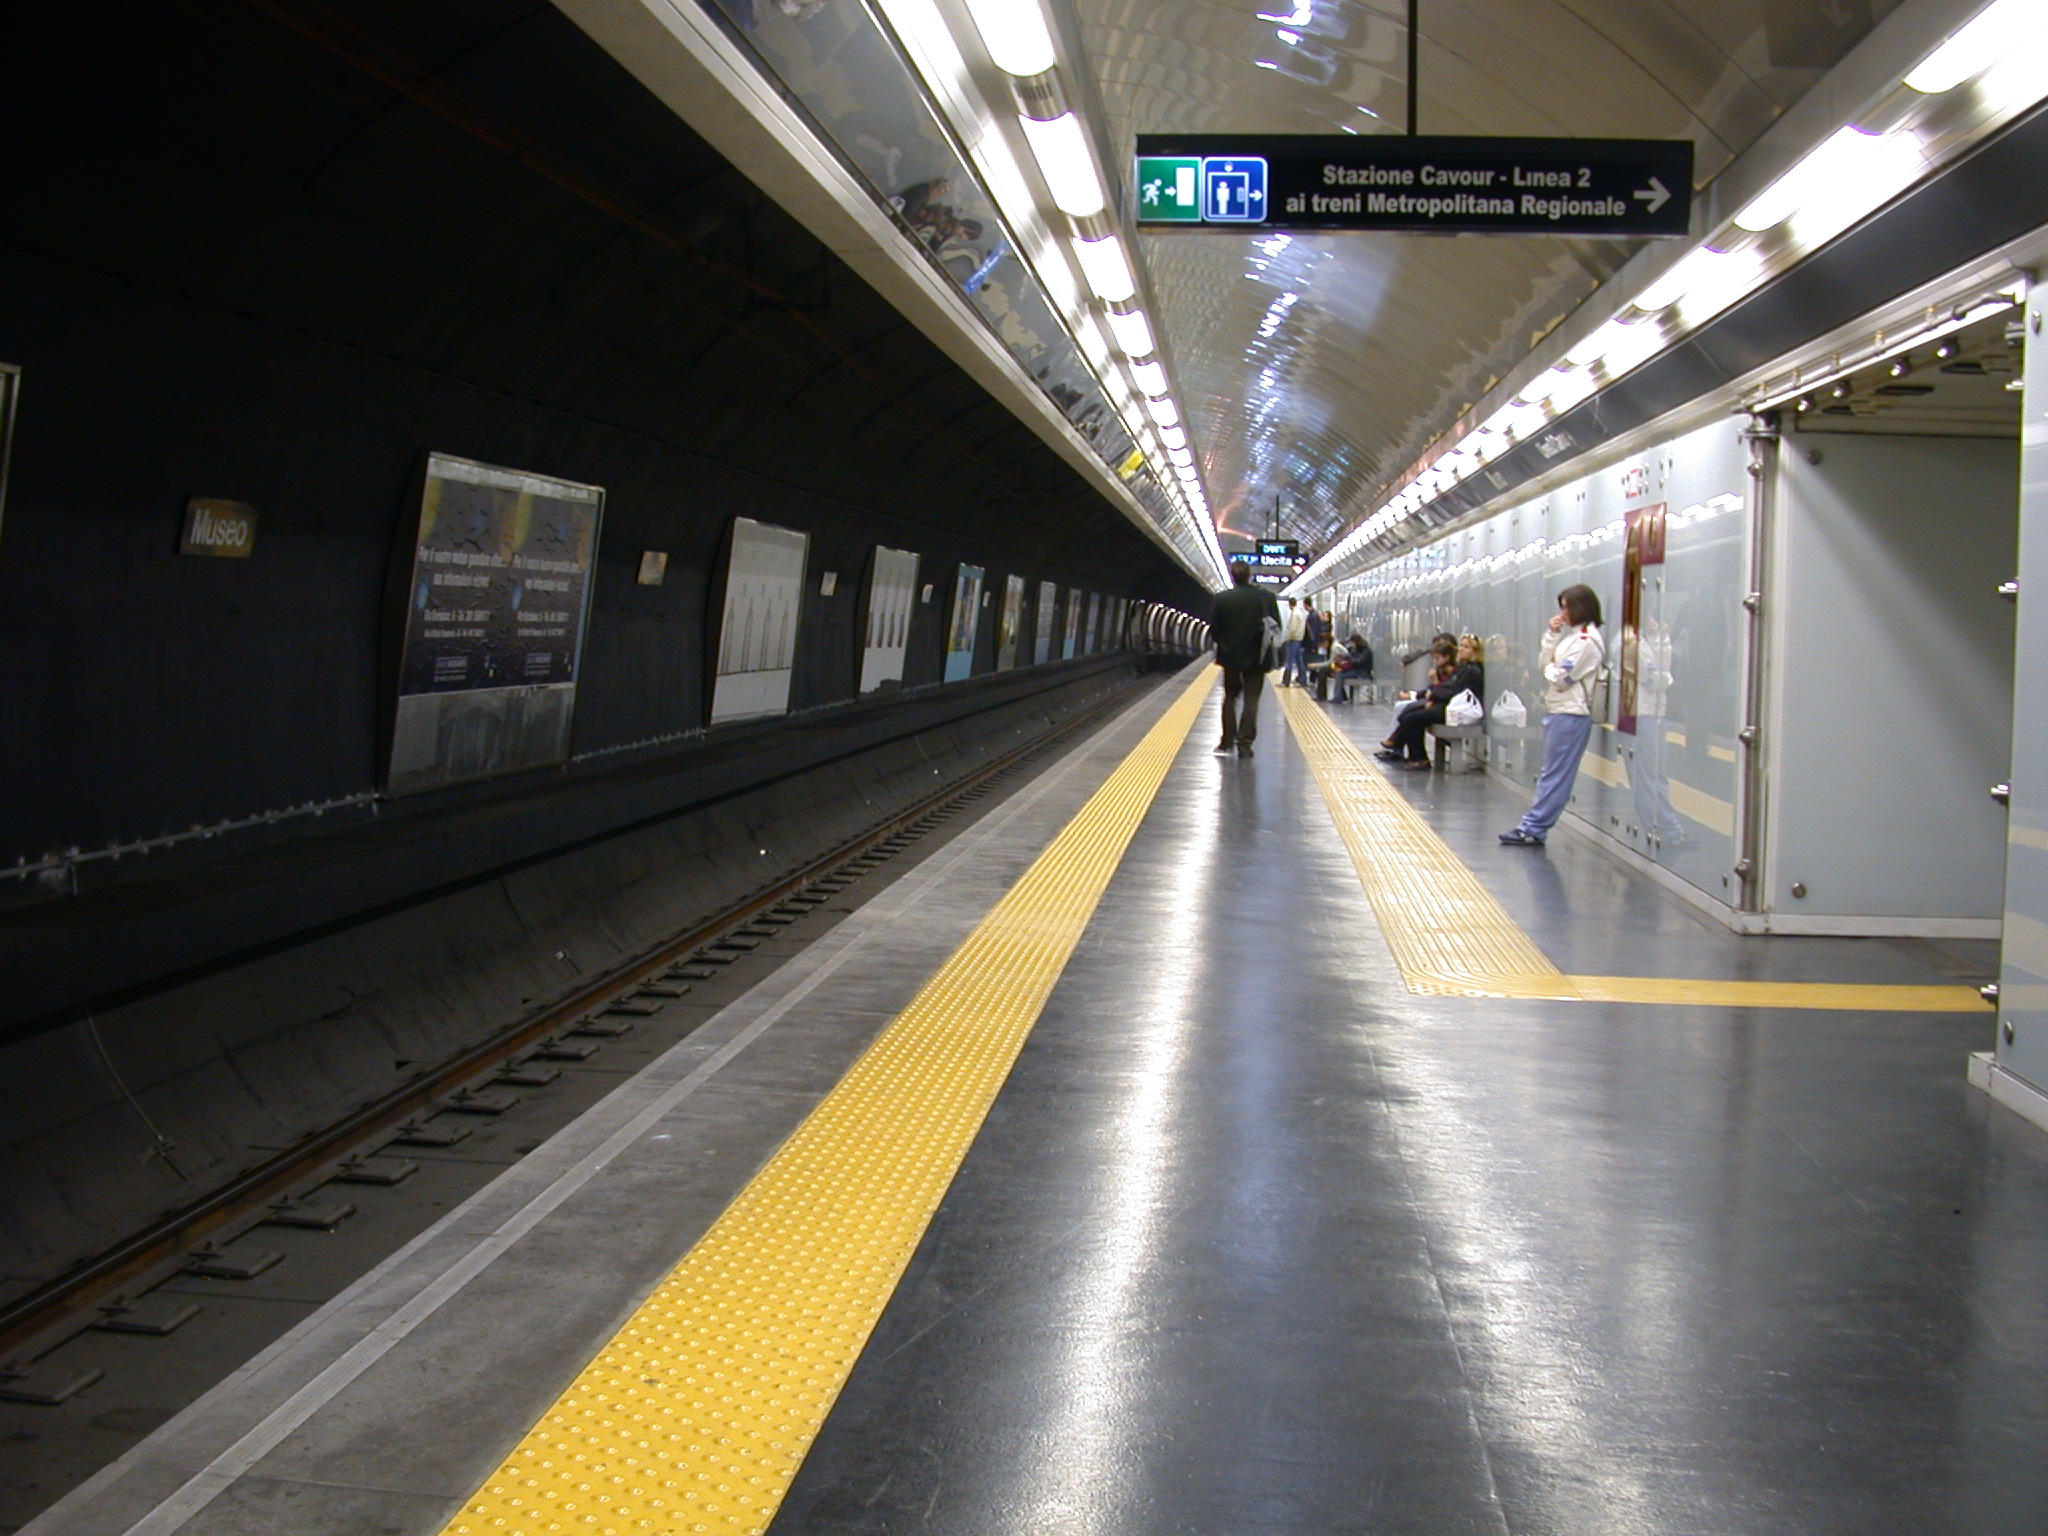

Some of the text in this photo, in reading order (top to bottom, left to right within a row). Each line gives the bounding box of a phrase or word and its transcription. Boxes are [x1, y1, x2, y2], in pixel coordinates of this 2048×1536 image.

[1323, 165, 1414, 185] Stazione
[1420, 166, 1494, 185] Cavour
[1513, 167, 1571, 187] Linea
[1577, 168, 1591, 187] 2
[1286, 193, 1626, 220] ai treni Metropolitana Regionale
[190, 508, 247, 546] Museo
[1261, 556, 1292, 565] Uscita
